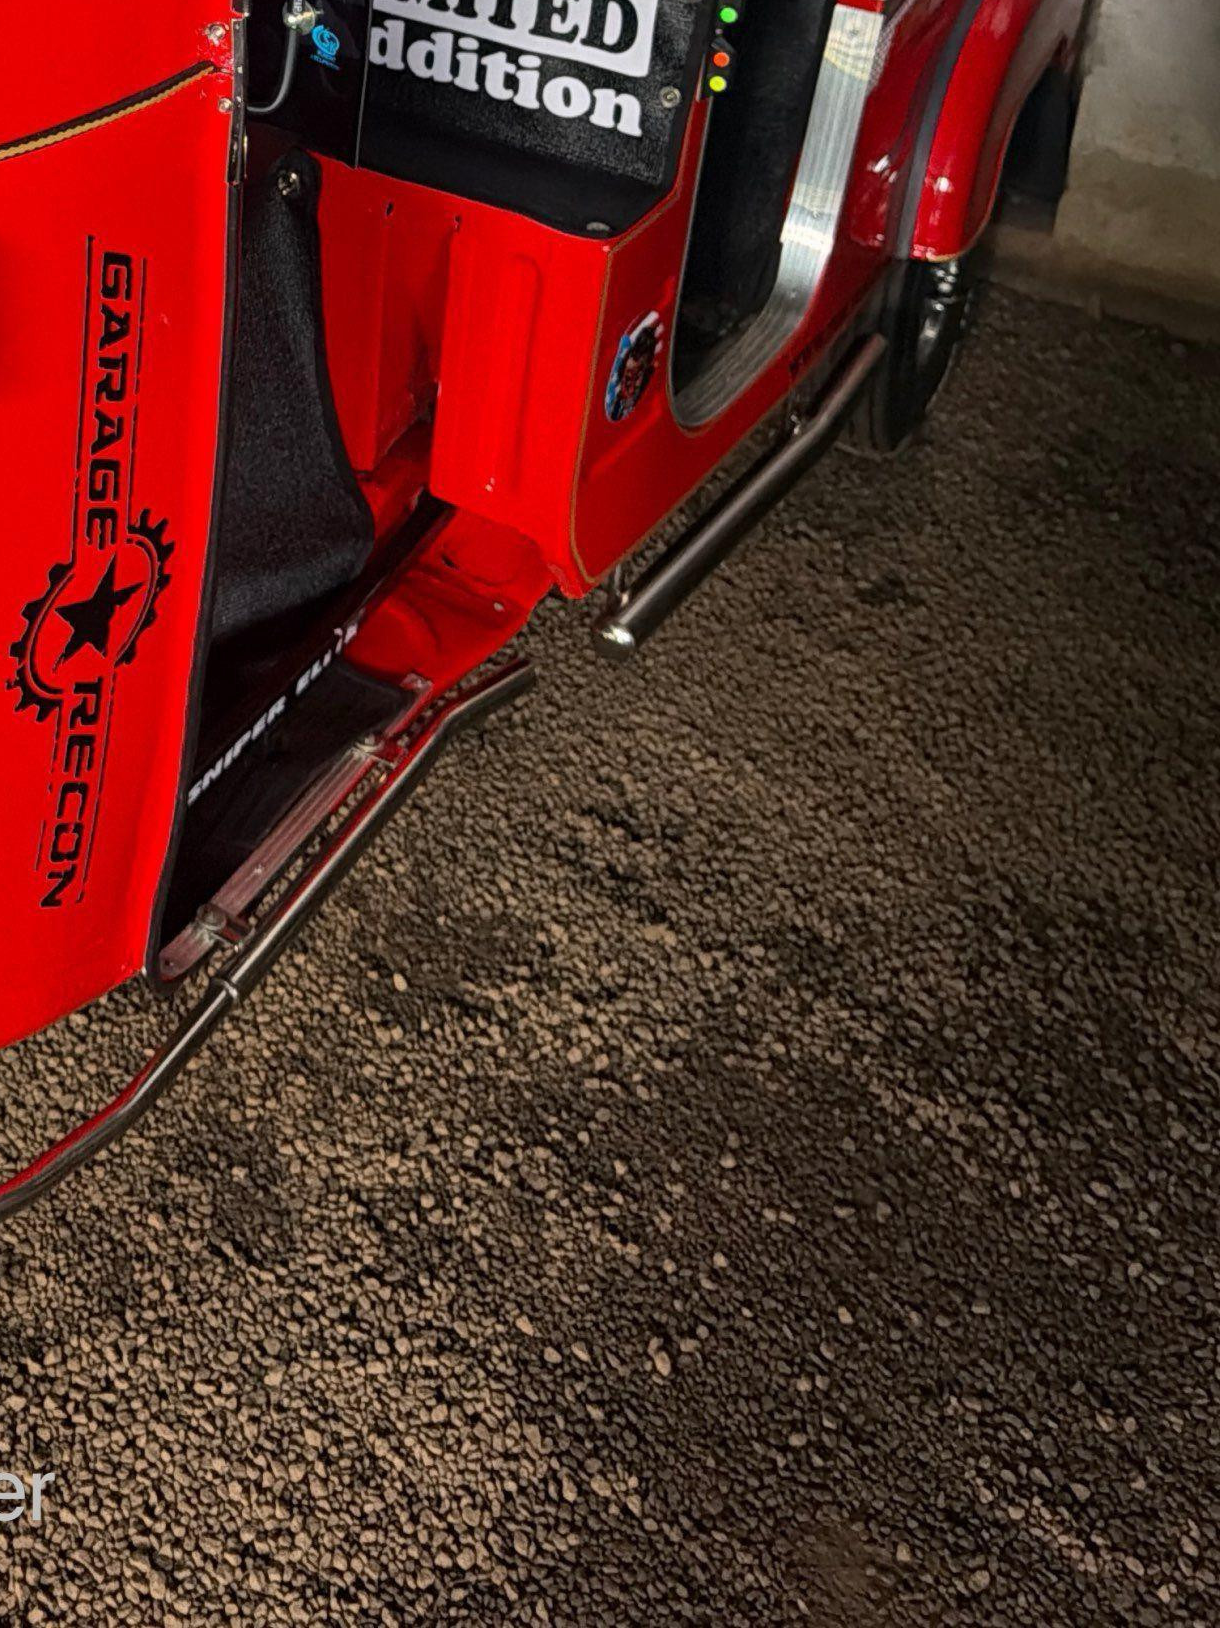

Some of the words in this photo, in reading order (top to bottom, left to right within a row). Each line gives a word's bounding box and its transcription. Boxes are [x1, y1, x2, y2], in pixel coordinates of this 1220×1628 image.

[368, 18, 643, 138] ddition
[85, 251, 134, 551] GARAGE
[39, 677, 101, 909] RECON
